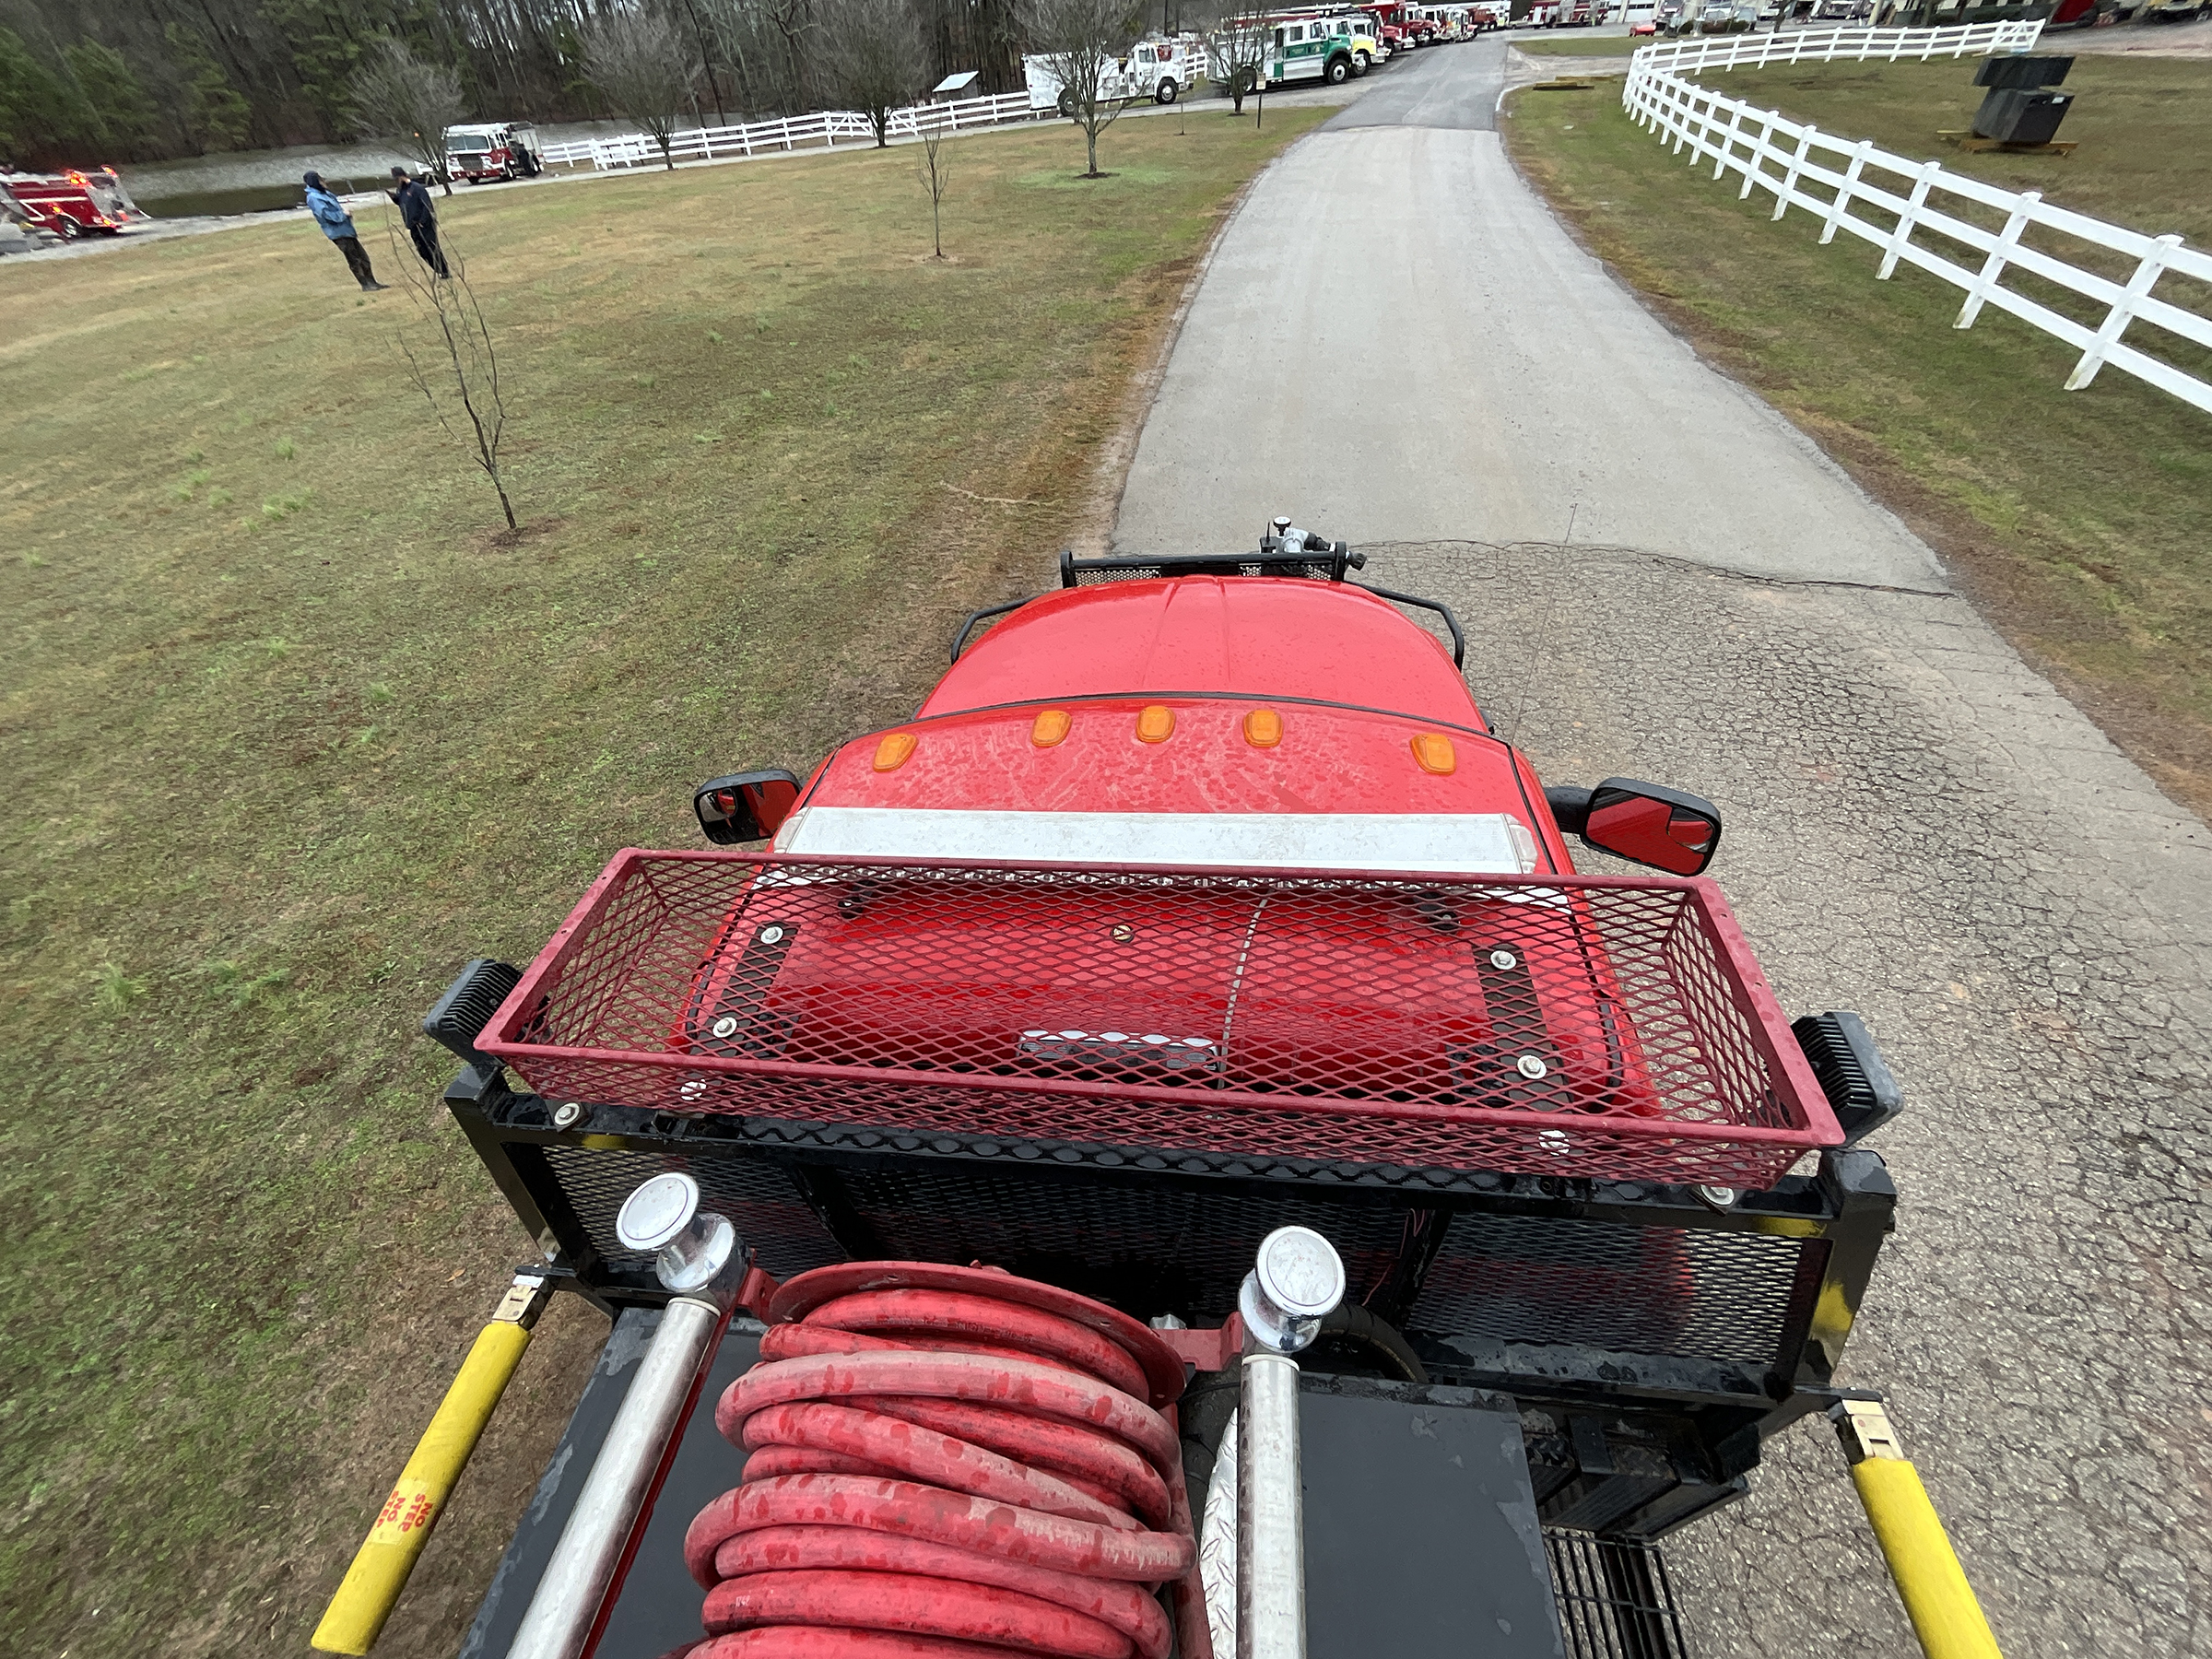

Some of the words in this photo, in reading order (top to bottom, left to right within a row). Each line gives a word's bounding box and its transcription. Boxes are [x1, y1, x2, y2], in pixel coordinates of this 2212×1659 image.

[387, 1498, 406, 1522] NO
[400, 1493, 426, 1533] STEP
[415, 1502, 433, 1527] NO
